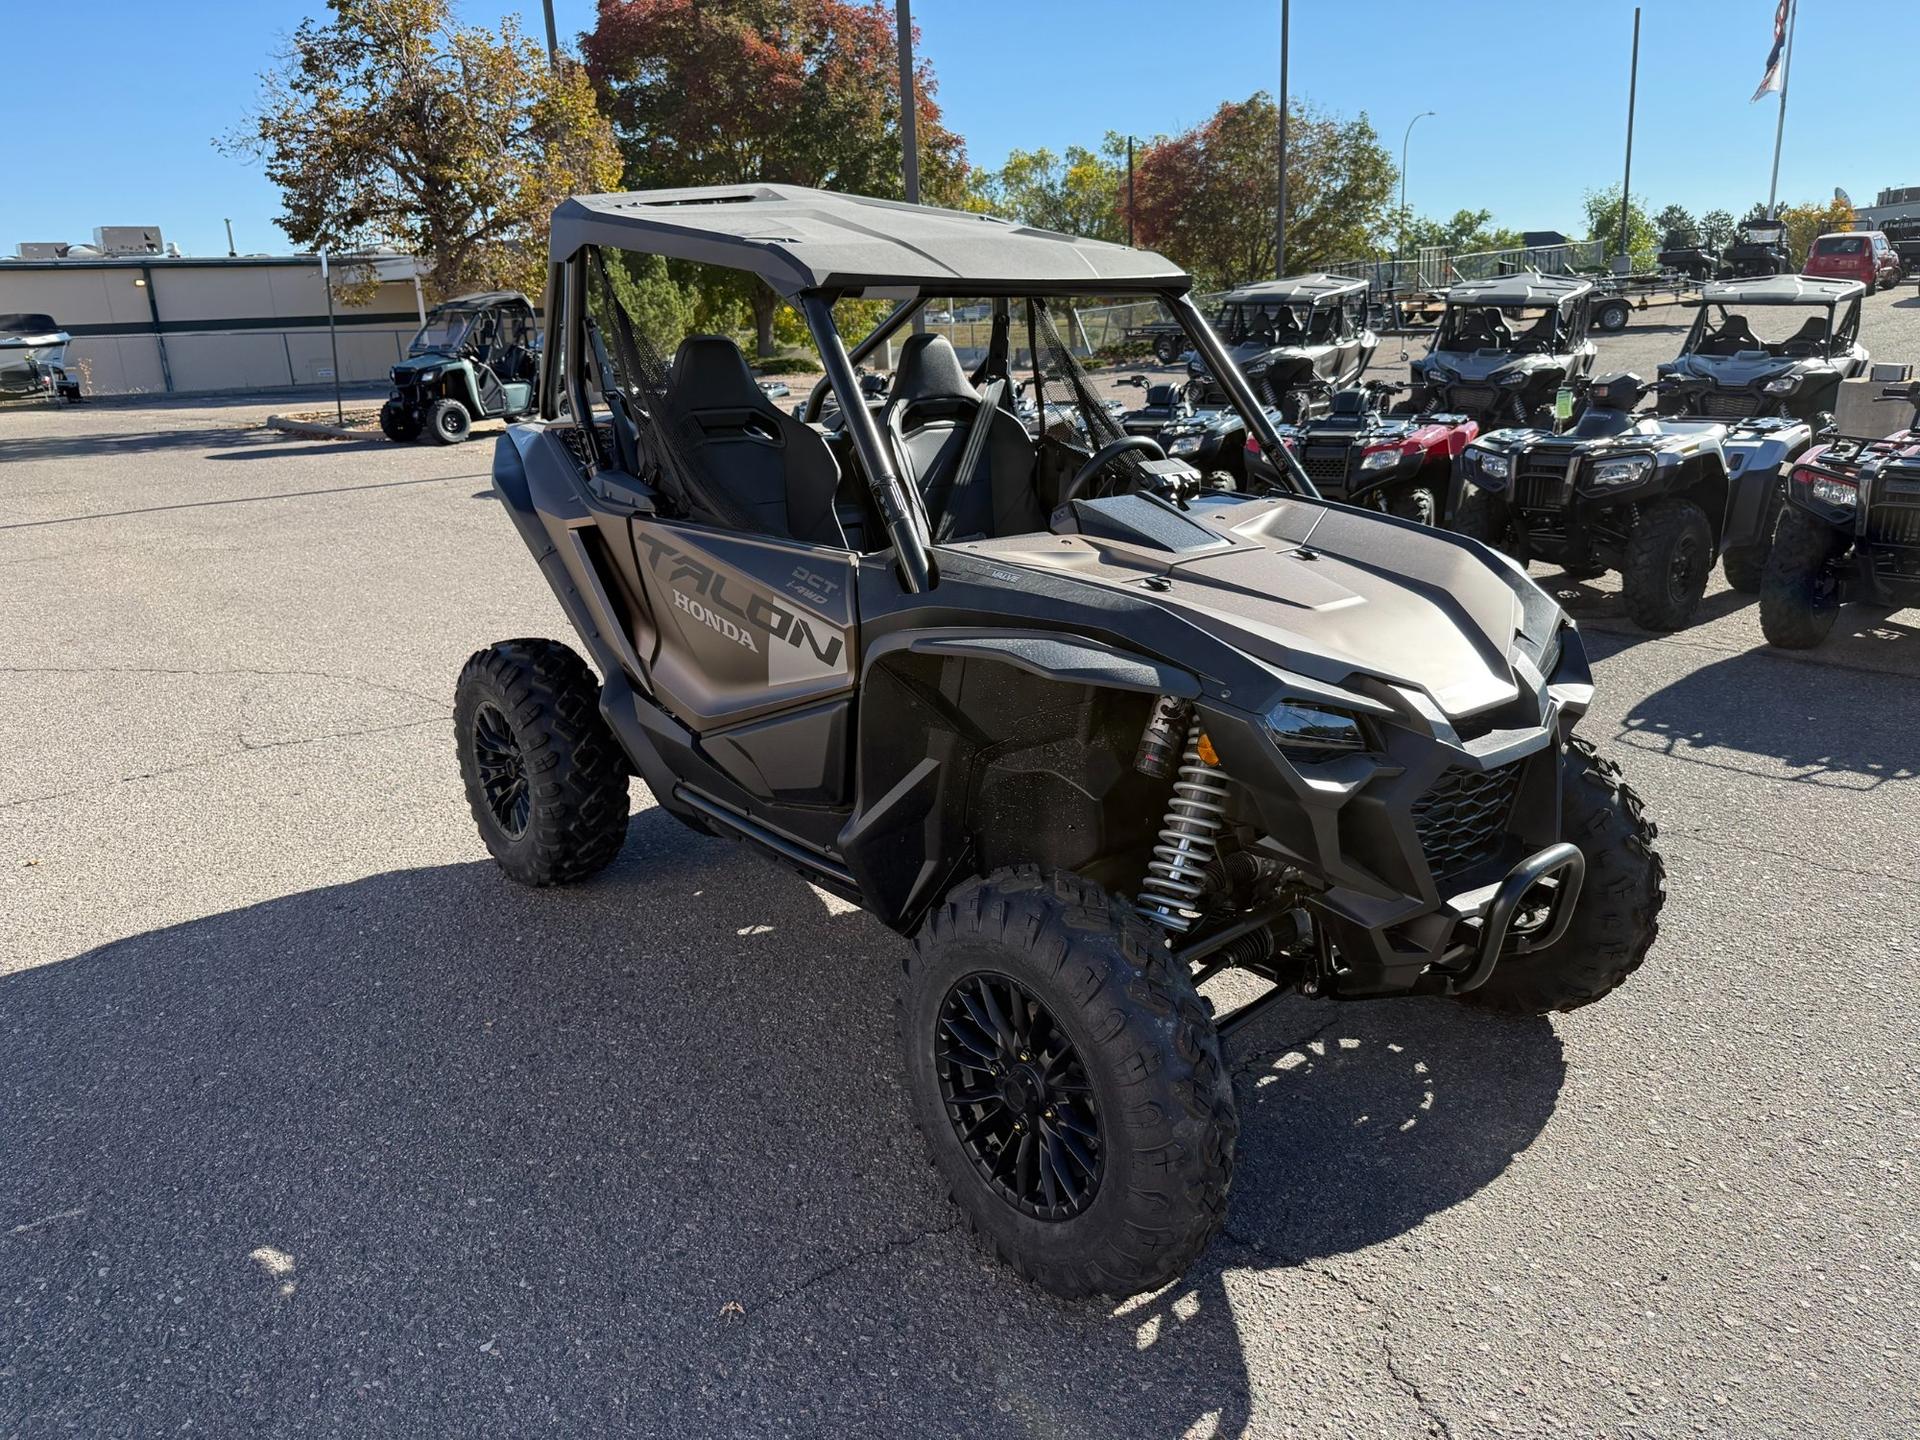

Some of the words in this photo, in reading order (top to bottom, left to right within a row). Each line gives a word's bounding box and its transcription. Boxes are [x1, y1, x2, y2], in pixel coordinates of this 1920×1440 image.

[638, 532, 843, 667] TALON
[792, 566, 839, 593] DCT
[673, 589, 759, 654] HONDA
